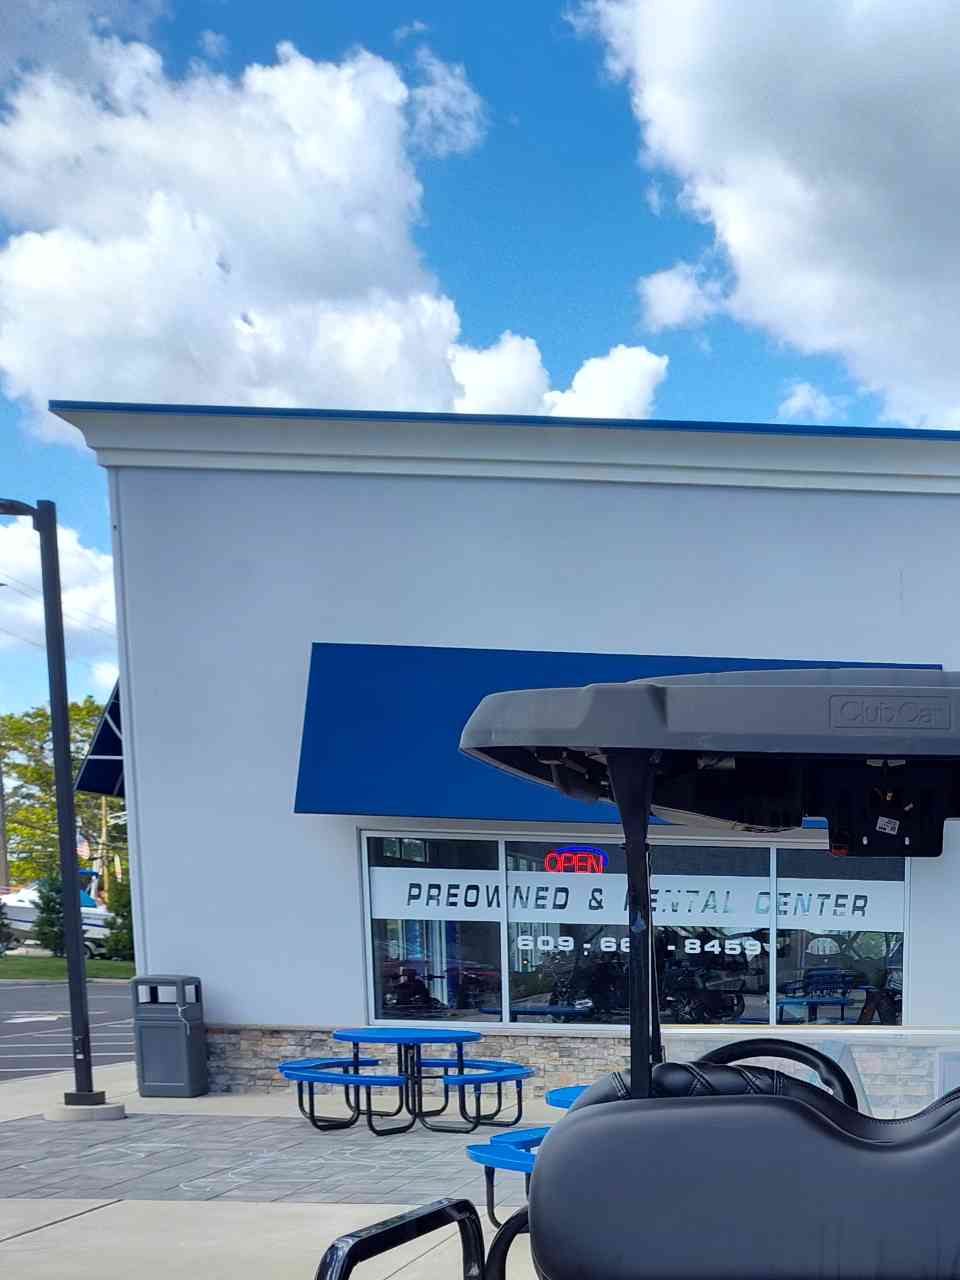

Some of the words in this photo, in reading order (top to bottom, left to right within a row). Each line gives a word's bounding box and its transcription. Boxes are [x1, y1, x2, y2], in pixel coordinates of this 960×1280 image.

[543, 850, 604, 874] OPEN
[406, 882, 570, 910] PREOWNED
[588, 887, 605, 911] &
[754, 891, 869, 917] CENTER
